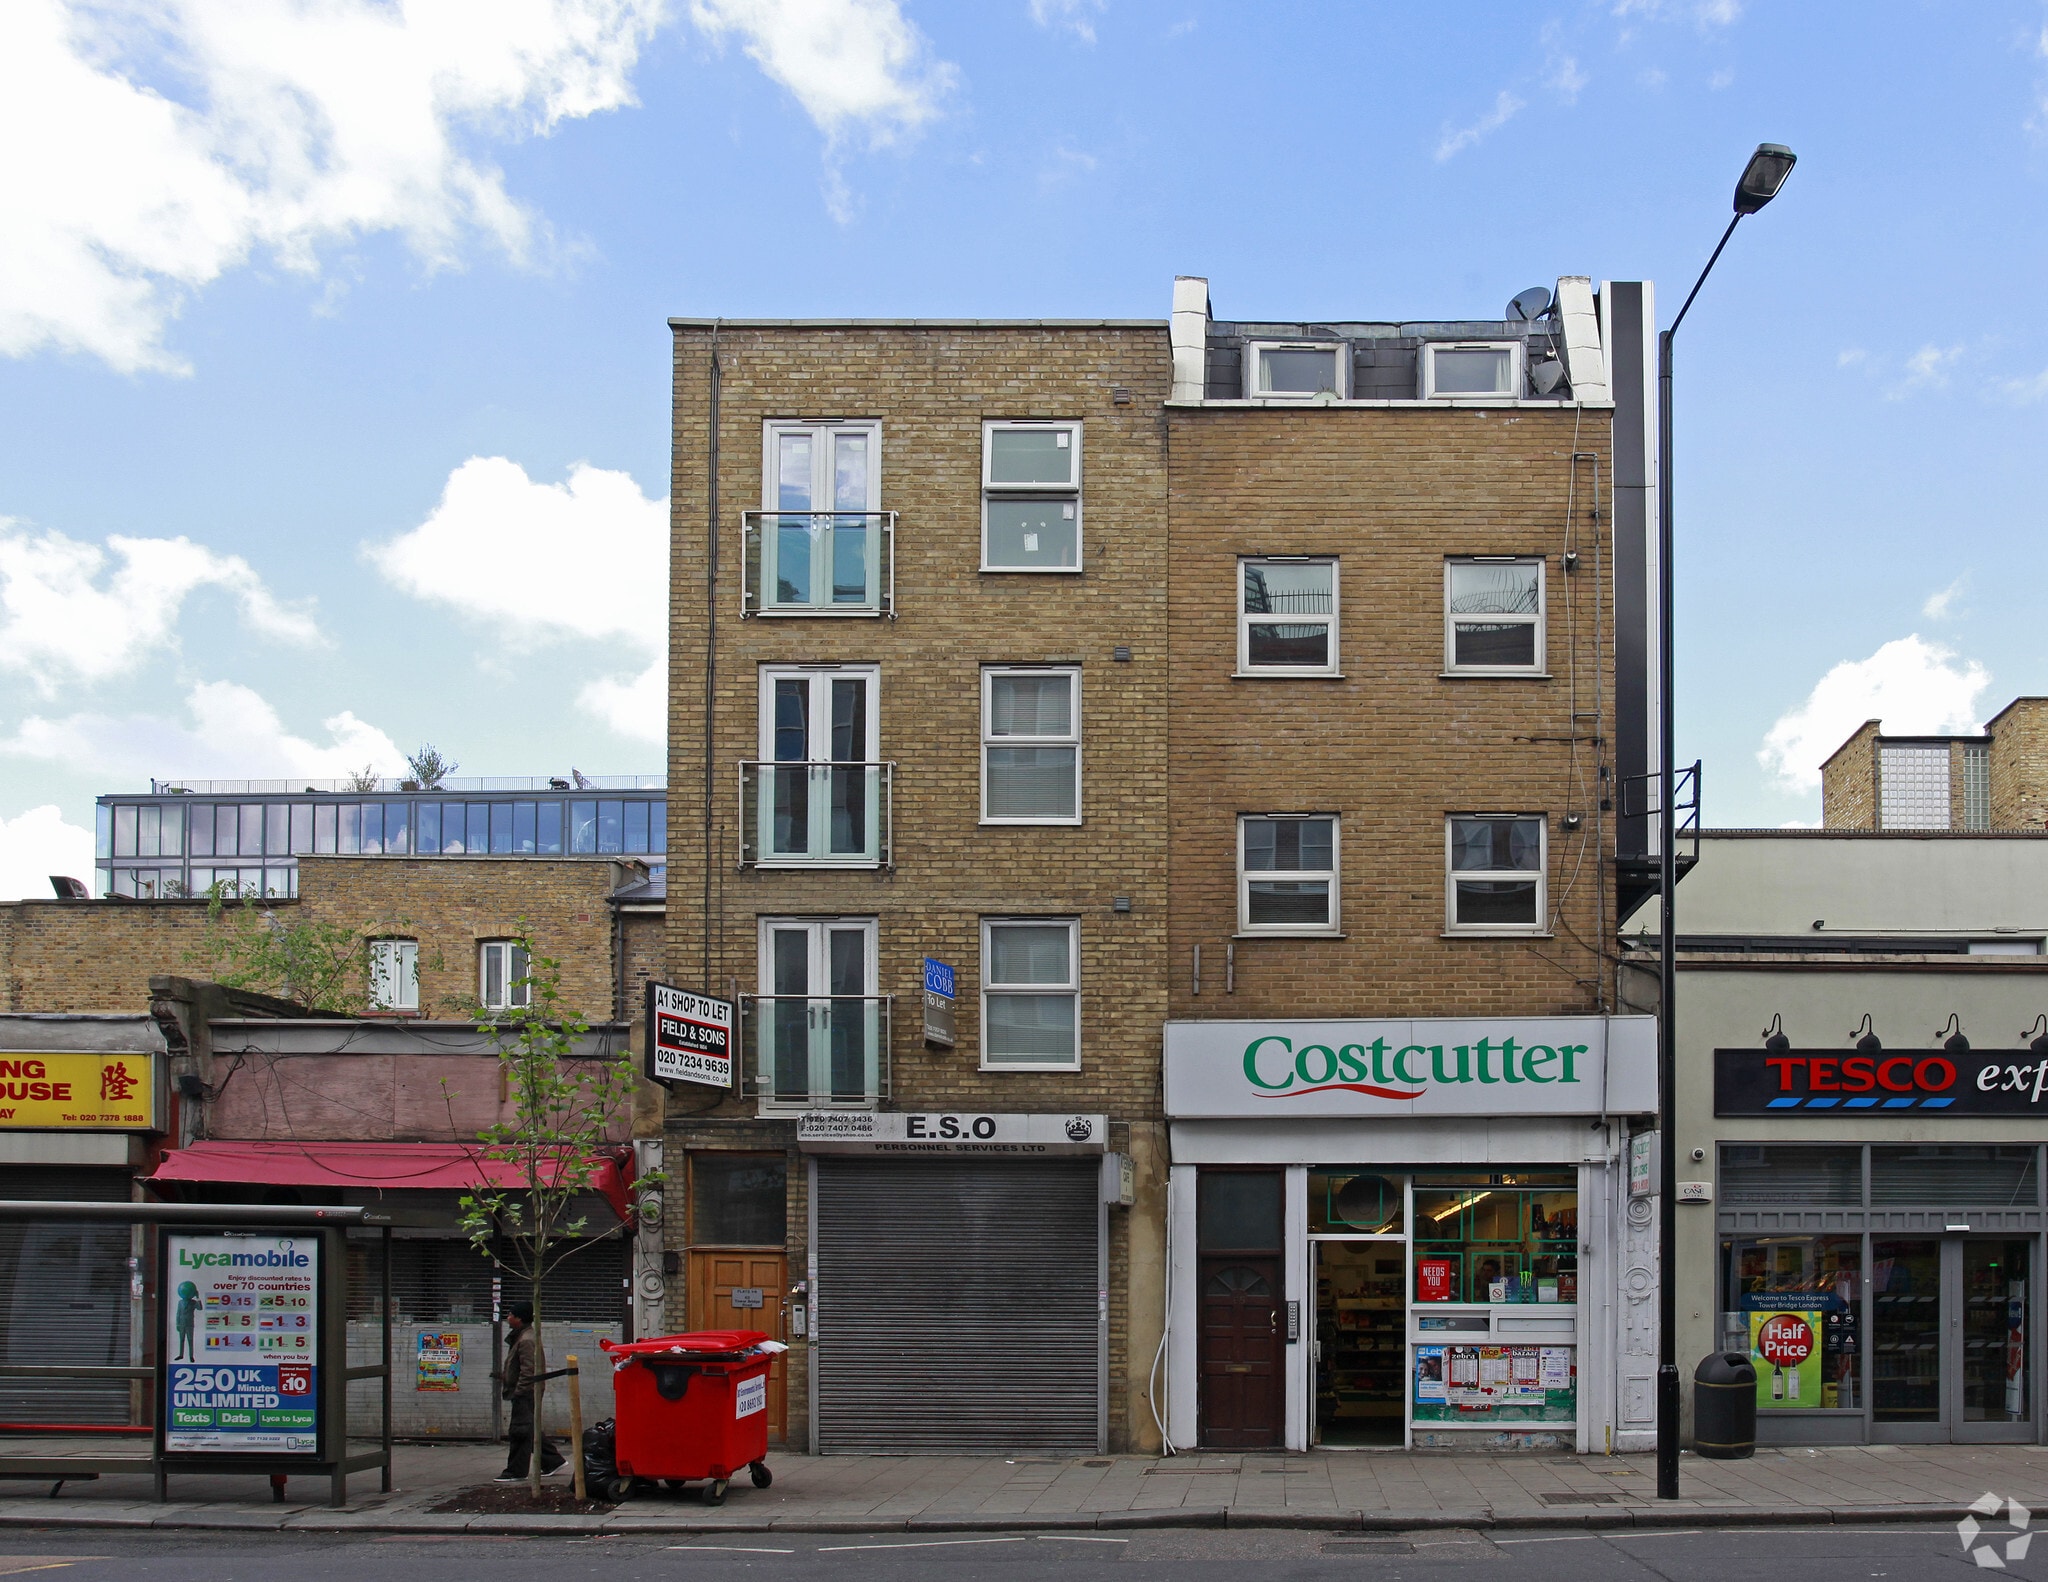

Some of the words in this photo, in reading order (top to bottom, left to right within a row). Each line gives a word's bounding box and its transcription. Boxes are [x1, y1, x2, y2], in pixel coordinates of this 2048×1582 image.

[925, 961, 953, 980] DANIEL
[926, 972, 953, 994] COBB
[657, 989, 669, 1007] A1
[671, 993, 696, 1013] SHOP
[698, 1000, 710, 1017] TO
[712, 1002, 728, 1021] LET
[927, 993, 936, 1006] To
[936, 996, 946, 1010] Let
[661, 1018, 687, 1038] FIELD
[689, 1025, 697, 1041] &
[698, 1027, 726, 1046] SONS
[657, 1049, 676, 1064] 020
[678, 1053, 703, 1070] 7234
[704, 1058, 729, 1075] 9639
[1243, 1035, 1589, 1089] Costcutter
[658, 1065, 729, 1083] www.fieldandsons.co.uk
[1765, 1057, 1957, 1092] TESCO
[100, 1061, 139, 1101] 隆
[79, 1114, 96, 1122] 020
[99, 1114, 120, 1122] 7378
[827, 1115, 849, 1123] 7407
[851, 1115, 873, 1123] 3436
[906, 1116, 996, 1139] E.S.O
[875, 1143, 951, 1151] PERSONNEL
[955, 1144, 1018, 1152] SERVICES
[179, 1248, 310, 1270] Lycamobile
[1422, 1266, 1445, 1277] NEEDS
[241, 1282, 255, 1290] 70
[257, 1282, 311, 1291] countries
[1427, 1276, 1440, 1287] YOU
[221, 1295, 231, 1306] 9
[236, 1297, 251, 1306] 15
[274, 1295, 285, 1306] 5
[292, 1298, 306, 1306] 10
[1805, 1294, 1829, 1302] Express
[1777, 1301, 1798, 1310] Bridge
[222, 1315, 229, 1326] 1
[241, 1315, 251, 1326] 5
[276, 1315, 283, 1327] 1
[295, 1316, 306, 1327] 3
[1768, 1323, 1806, 1340] Half
[222, 1335, 229, 1346] 1
[241, 1335, 252, 1346] 4
[276, 1336, 283, 1347] 1
[295, 1336, 305, 1347] 5
[1481, 1348, 1499, 1356] nice
[1764, 1341, 1808, 1357] Price
[173, 1368, 236, 1392] 250
[237, 1369, 262, 1382] UK
[282, 1376, 307, 1391] £10
[237, 1384, 277, 1392] Minutes
[173, 1393, 280, 1408] UNLIMITED
[176, 1412, 210, 1423] Texts
[222, 1413, 251, 1423] Data
[261, 1415, 280, 1423] Lyca
[292, 1415, 312, 1423] Lyca
[297, 1438, 315, 1446] Lyca
